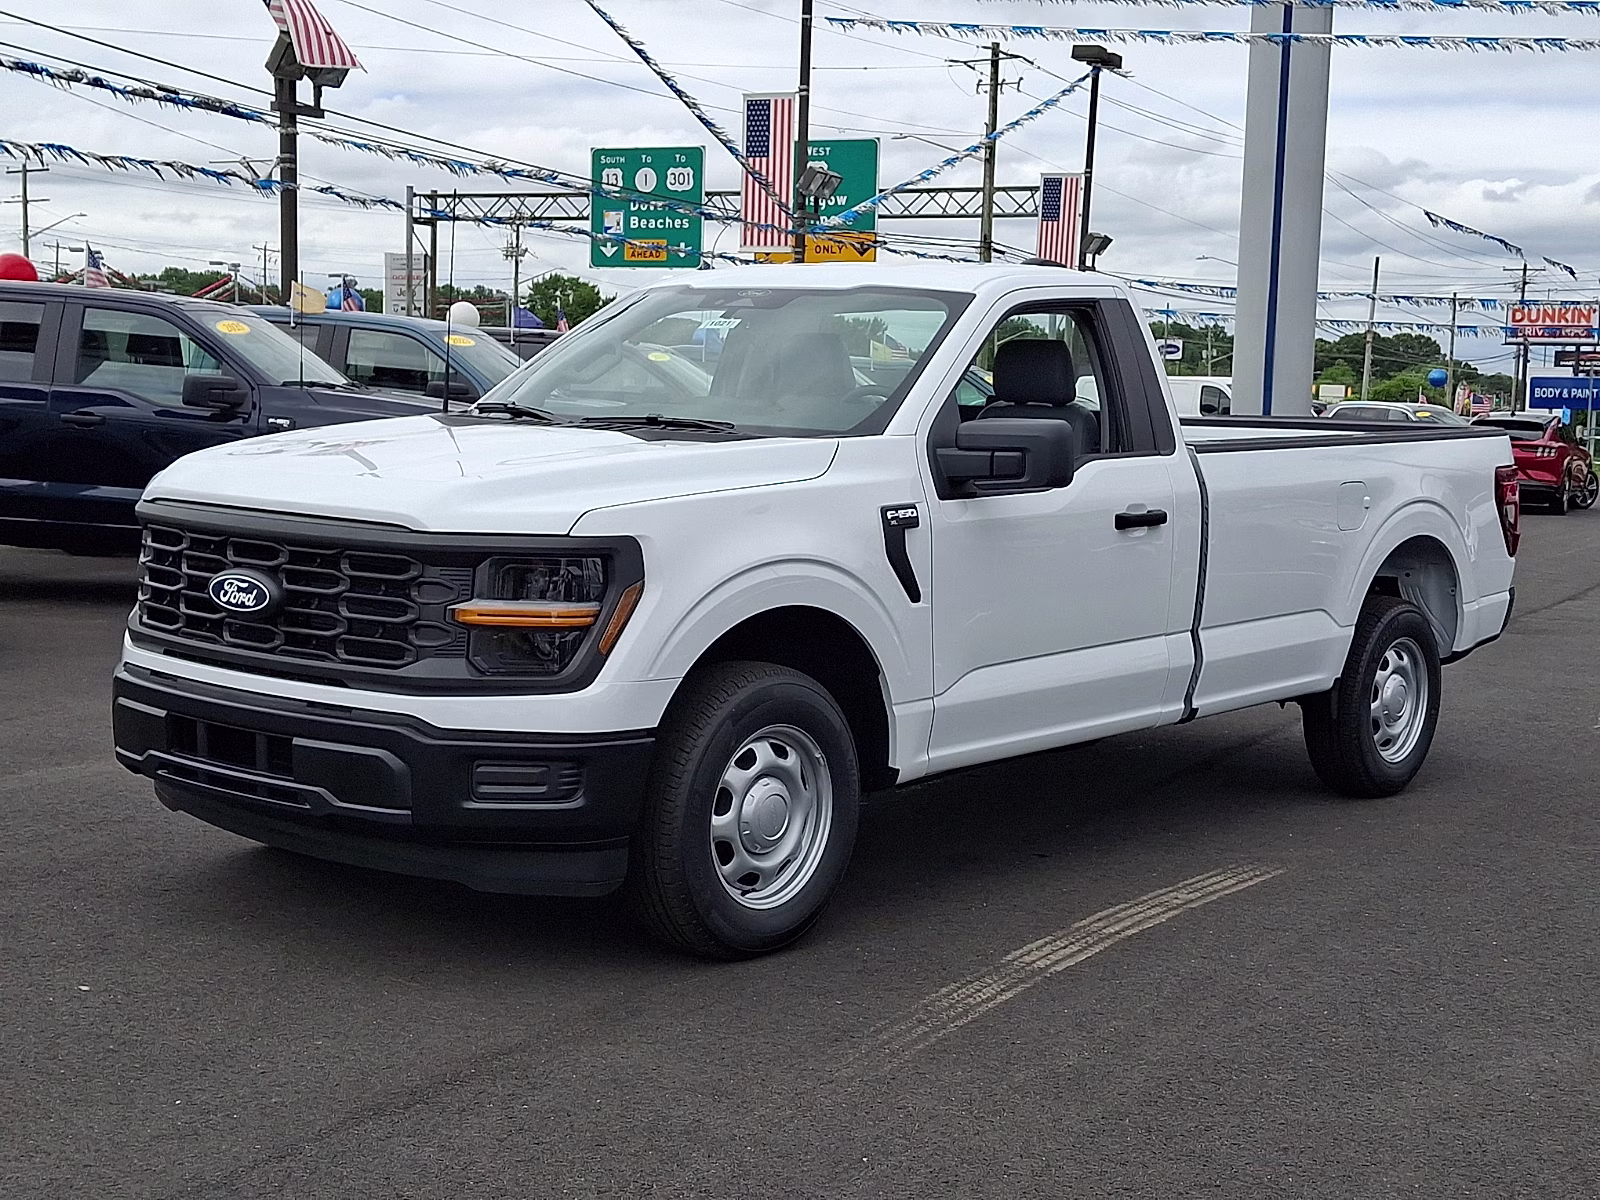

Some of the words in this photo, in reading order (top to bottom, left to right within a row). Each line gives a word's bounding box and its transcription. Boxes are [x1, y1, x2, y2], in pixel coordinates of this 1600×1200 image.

[600, 155, 626, 164] SOUTH
[641, 154, 652, 163] TO
[675, 154, 687, 163] TO
[606, 173, 619, 186] 13
[669, 172, 691, 186] 301
[630, 216, 690, 229] Beaches
[630, 250, 661, 259] AHEAD
[814, 245, 844, 254] ONLY
[396, 287, 417, 300] Jep
[1511, 307, 1597, 324] DUNKIN'
[1534, 388, 1561, 399] BODY
[1562, 388, 1569, 399] &
[1570, 388, 1599, 399] PAINT
[220, 579, 258, 606] Ford
